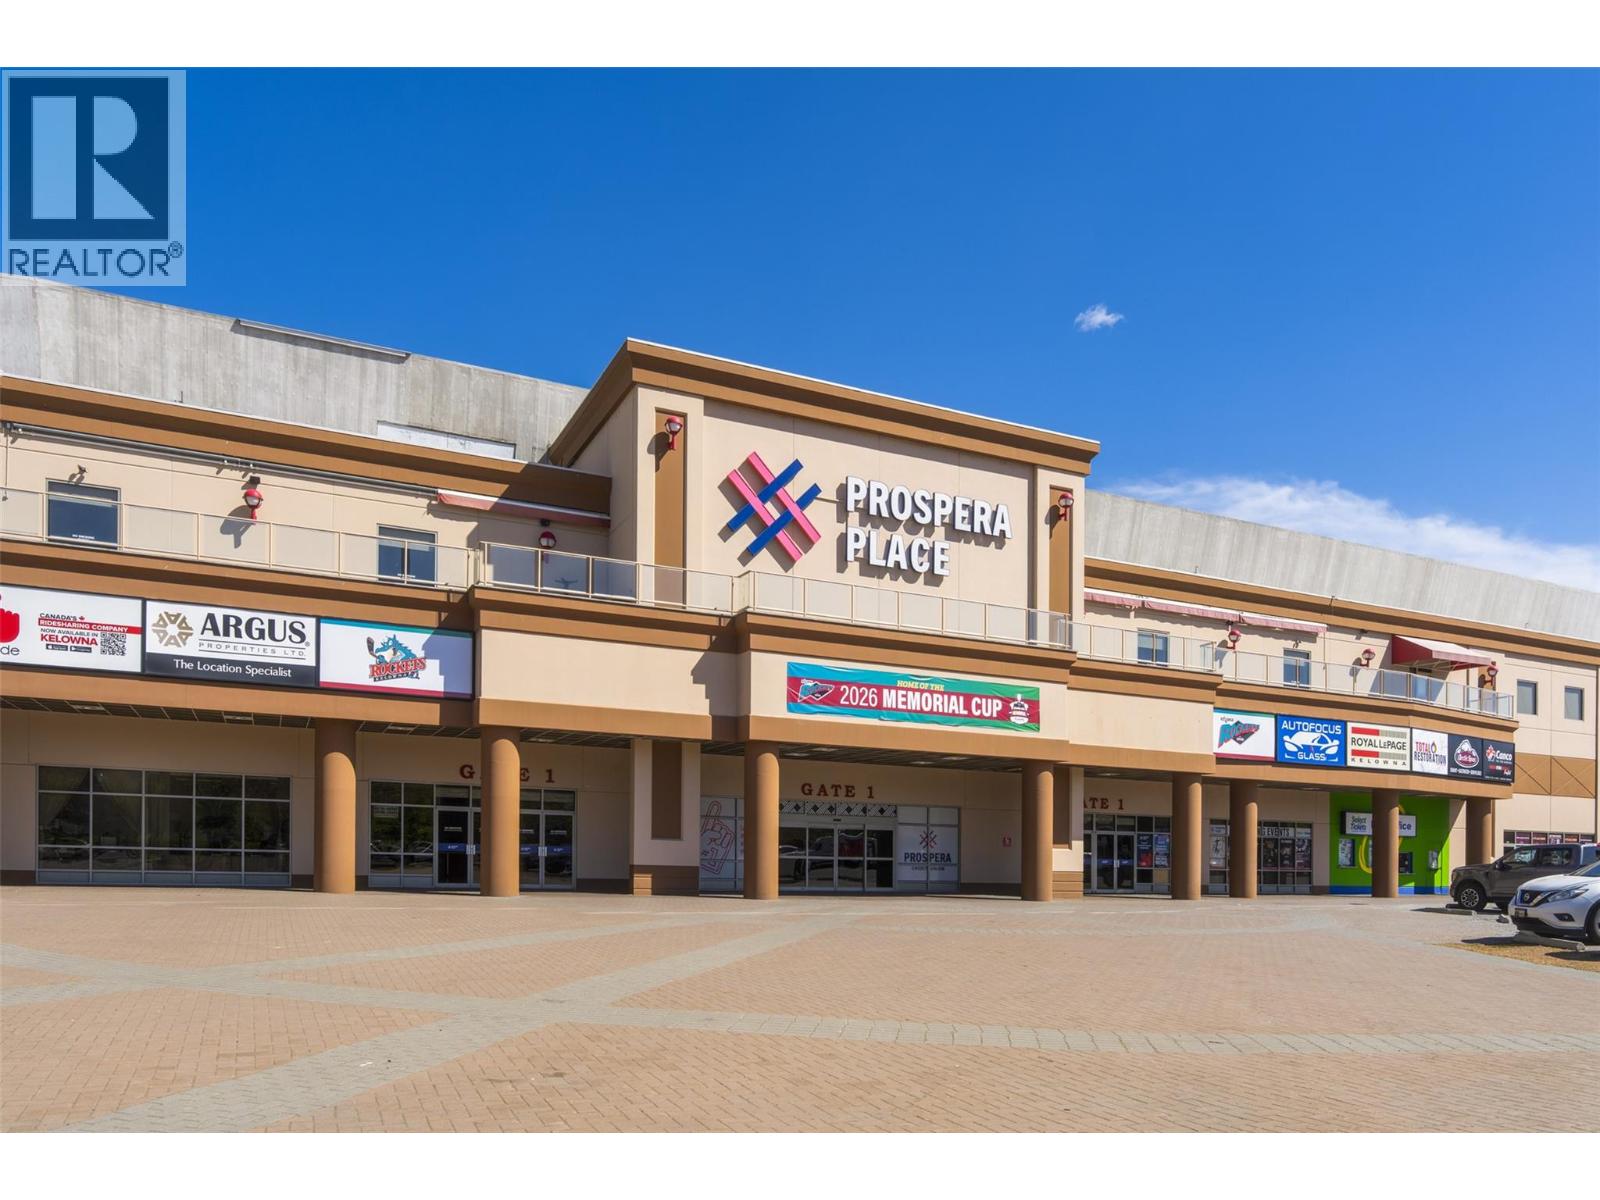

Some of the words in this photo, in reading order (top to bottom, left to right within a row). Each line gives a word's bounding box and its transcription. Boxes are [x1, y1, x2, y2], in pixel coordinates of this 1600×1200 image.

[846, 475, 1013, 539] PROSPERA
[846, 526, 950, 577] PLACE
[39, 612, 78, 621] CANADA'S
[40, 619, 90, 630] RIDESHARING
[91, 624, 129, 633] COMPANY
[200, 612, 307, 644] ARGUS
[40, 633, 98, 646] KELOWNA
[57, 629, 91, 637] AVAILABLE
[198, 642, 277, 654] PROPERTIES
[173, 658, 194, 670] The
[197, 661, 242, 674] Location
[245, 665, 292, 678] Specialist
[896, 680, 919, 689] HOME
[919, 682, 929, 690] OF
[929, 682, 945, 691] THE
[839, 685, 878, 708] 2026
[882, 688, 968, 715] MEMORIAL
[970, 697, 1002, 718] CUP
[1281, 720, 1342, 735] AUTOFOCUS
[1351, 736, 1379, 749] ROYAL
[1415, 741, 1431, 752] TOTAL
[1297, 751, 1326, 761] GLASS
[1351, 758, 1407, 767] KELOWNA
[1414, 751, 1447, 766] RESTORATION
[459, 764, 530, 782] GE
[545, 768, 556, 783] 1
[801, 782, 856, 798] GATE
[866, 786, 875, 799] 1
[1117, 798, 1125, 810] 1
[904, 852, 952, 864] PROSPERA
